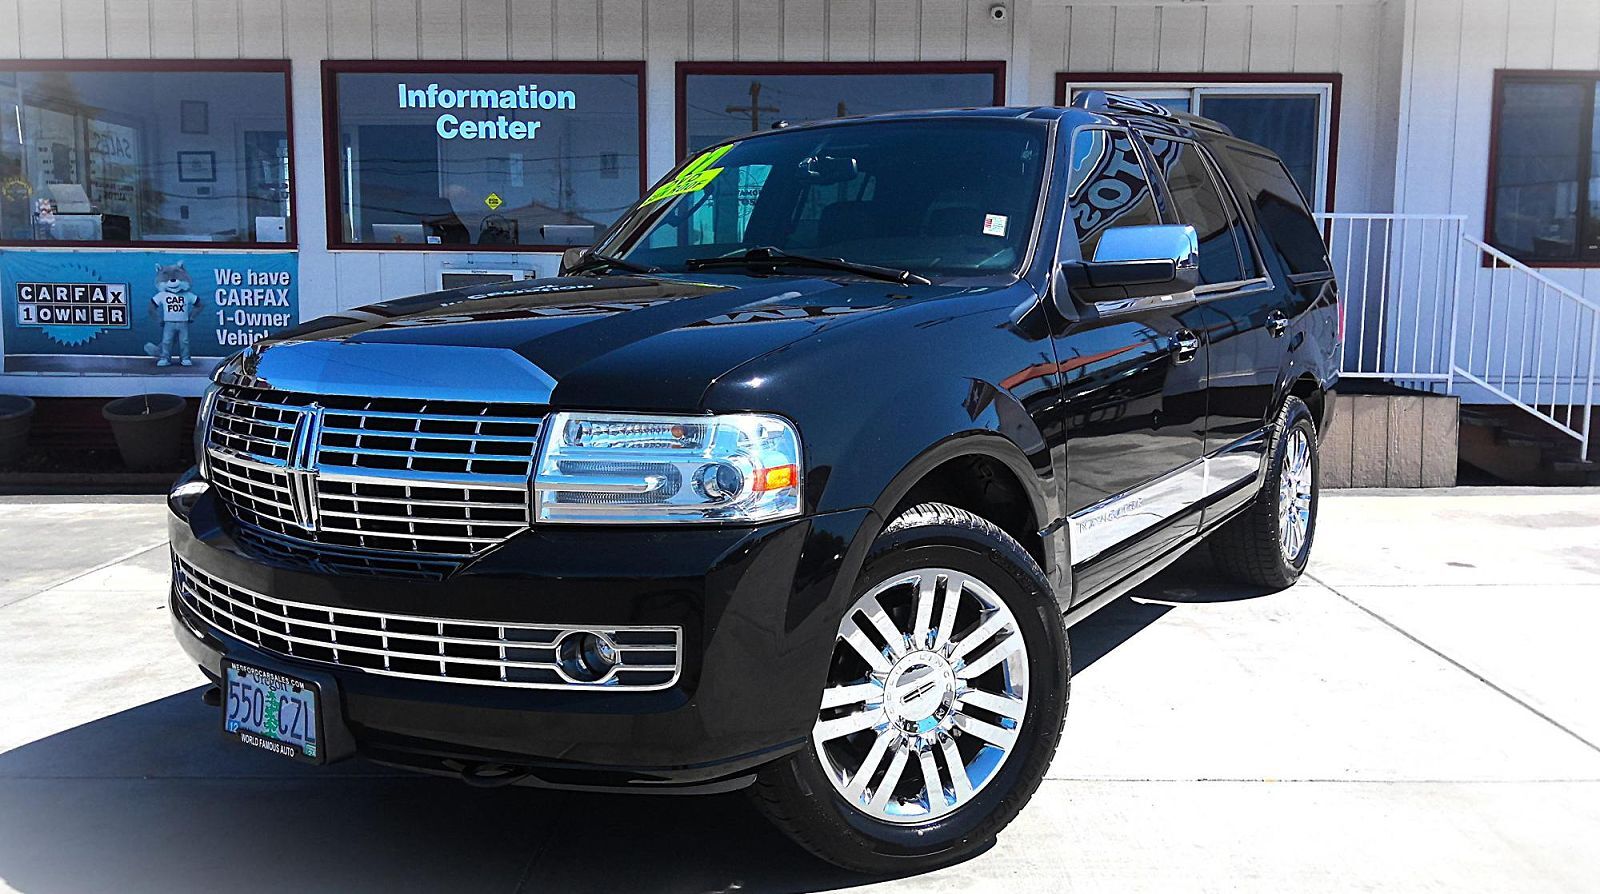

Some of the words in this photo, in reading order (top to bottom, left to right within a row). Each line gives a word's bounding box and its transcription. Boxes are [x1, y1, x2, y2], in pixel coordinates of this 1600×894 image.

[398, 83, 576, 109] Information
[436, 113, 541, 139] Center
[214, 269, 242, 285] We
[247, 269, 290, 285] have
[20, 286, 123, 303] CARFAX
[166, 296, 185, 305] CAR
[215, 288, 290, 307] CARFAX
[167, 304, 185, 312] FOX
[216, 310, 290, 326] 1-Owner
[229, 681, 264, 727] 550
[278, 695, 316, 743] CZL
[241, 733, 259, 747] WORLD
[259, 738, 280, 753] FAMOUS
[280, 745, 295, 757] AUTO
